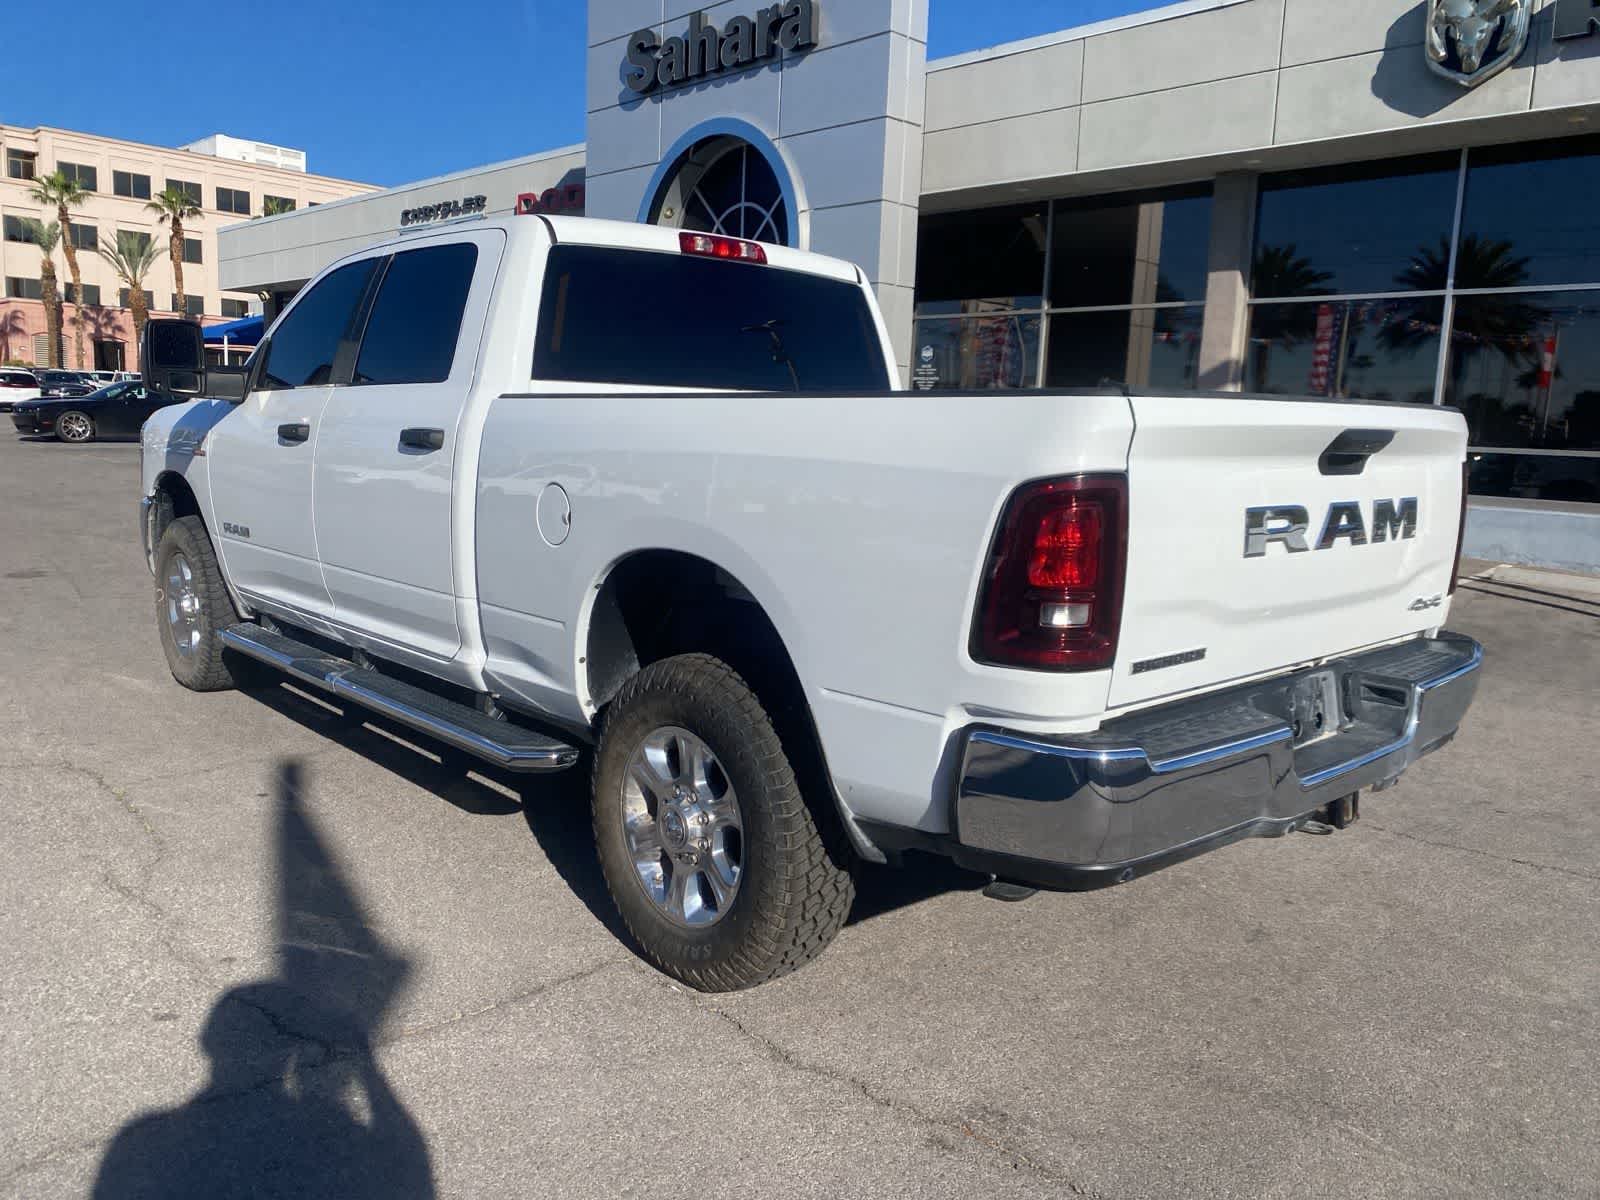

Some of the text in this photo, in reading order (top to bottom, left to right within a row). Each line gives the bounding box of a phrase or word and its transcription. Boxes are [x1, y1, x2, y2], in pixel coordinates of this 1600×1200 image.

[626, 0, 819, 92] Sahara
[401, 194, 487, 226] CHRYSLER
[223, 521, 250, 538] RAM
[1243, 496, 1418, 558] RAM
